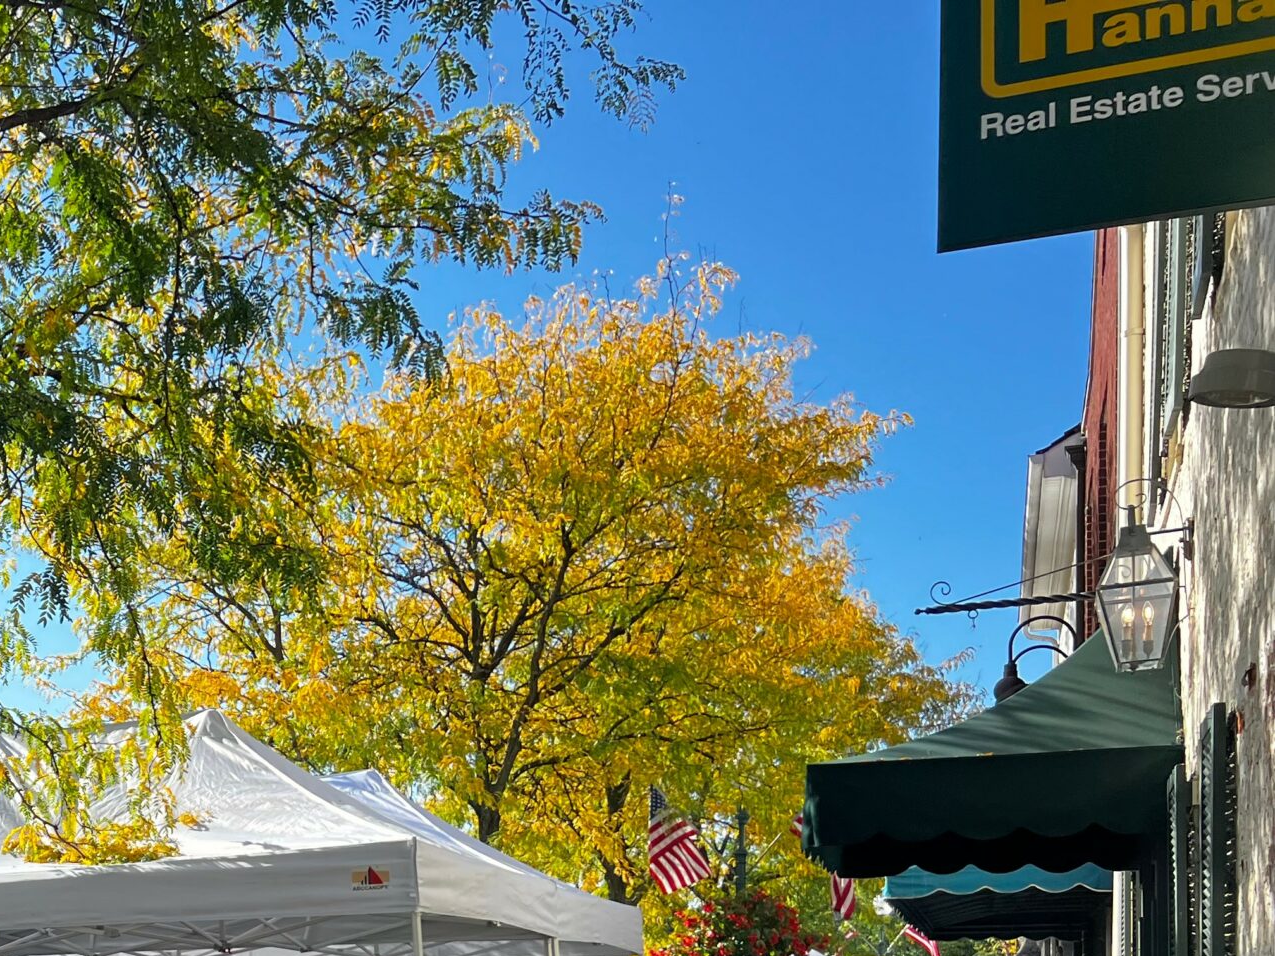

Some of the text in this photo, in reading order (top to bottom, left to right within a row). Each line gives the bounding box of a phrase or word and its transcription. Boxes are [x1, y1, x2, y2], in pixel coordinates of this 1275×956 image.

[980, 70, 1275, 140] Real Estate Serv
